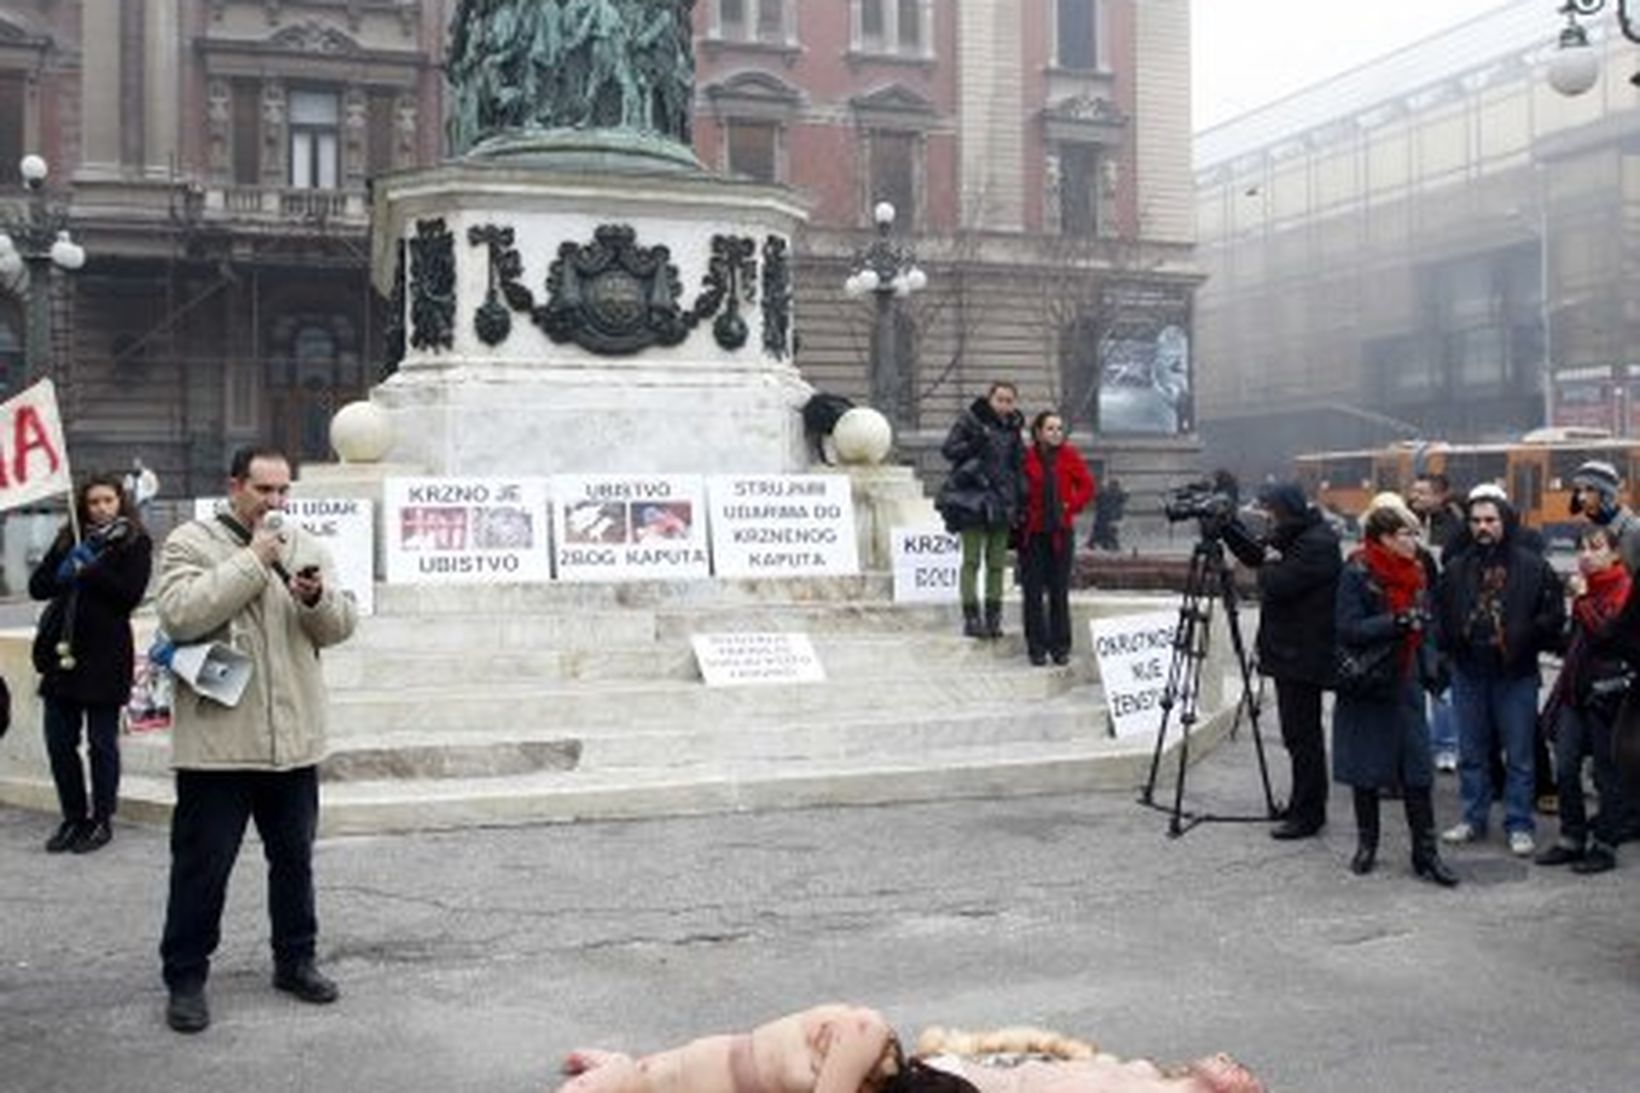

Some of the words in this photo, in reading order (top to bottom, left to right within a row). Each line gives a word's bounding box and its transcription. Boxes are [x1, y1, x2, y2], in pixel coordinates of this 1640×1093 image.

[0, 404, 59, 489] A
[408, 485, 489, 502] KRZNO
[495, 484, 521, 501] JE
[585, 482, 672, 496] UBISTVO
[813, 505, 842, 520] DO
[733, 528, 838, 544] KRZNENOG
[904, 535, 961, 554] KRZN
[418, 553, 521, 574] UBISTVO
[625, 550, 706, 566] KAPUTA
[748, 553, 826, 567] KAPUTA
[1096, 627, 1175, 657] OKRUTNO
[1111, 689, 1158, 717] ŽENST
